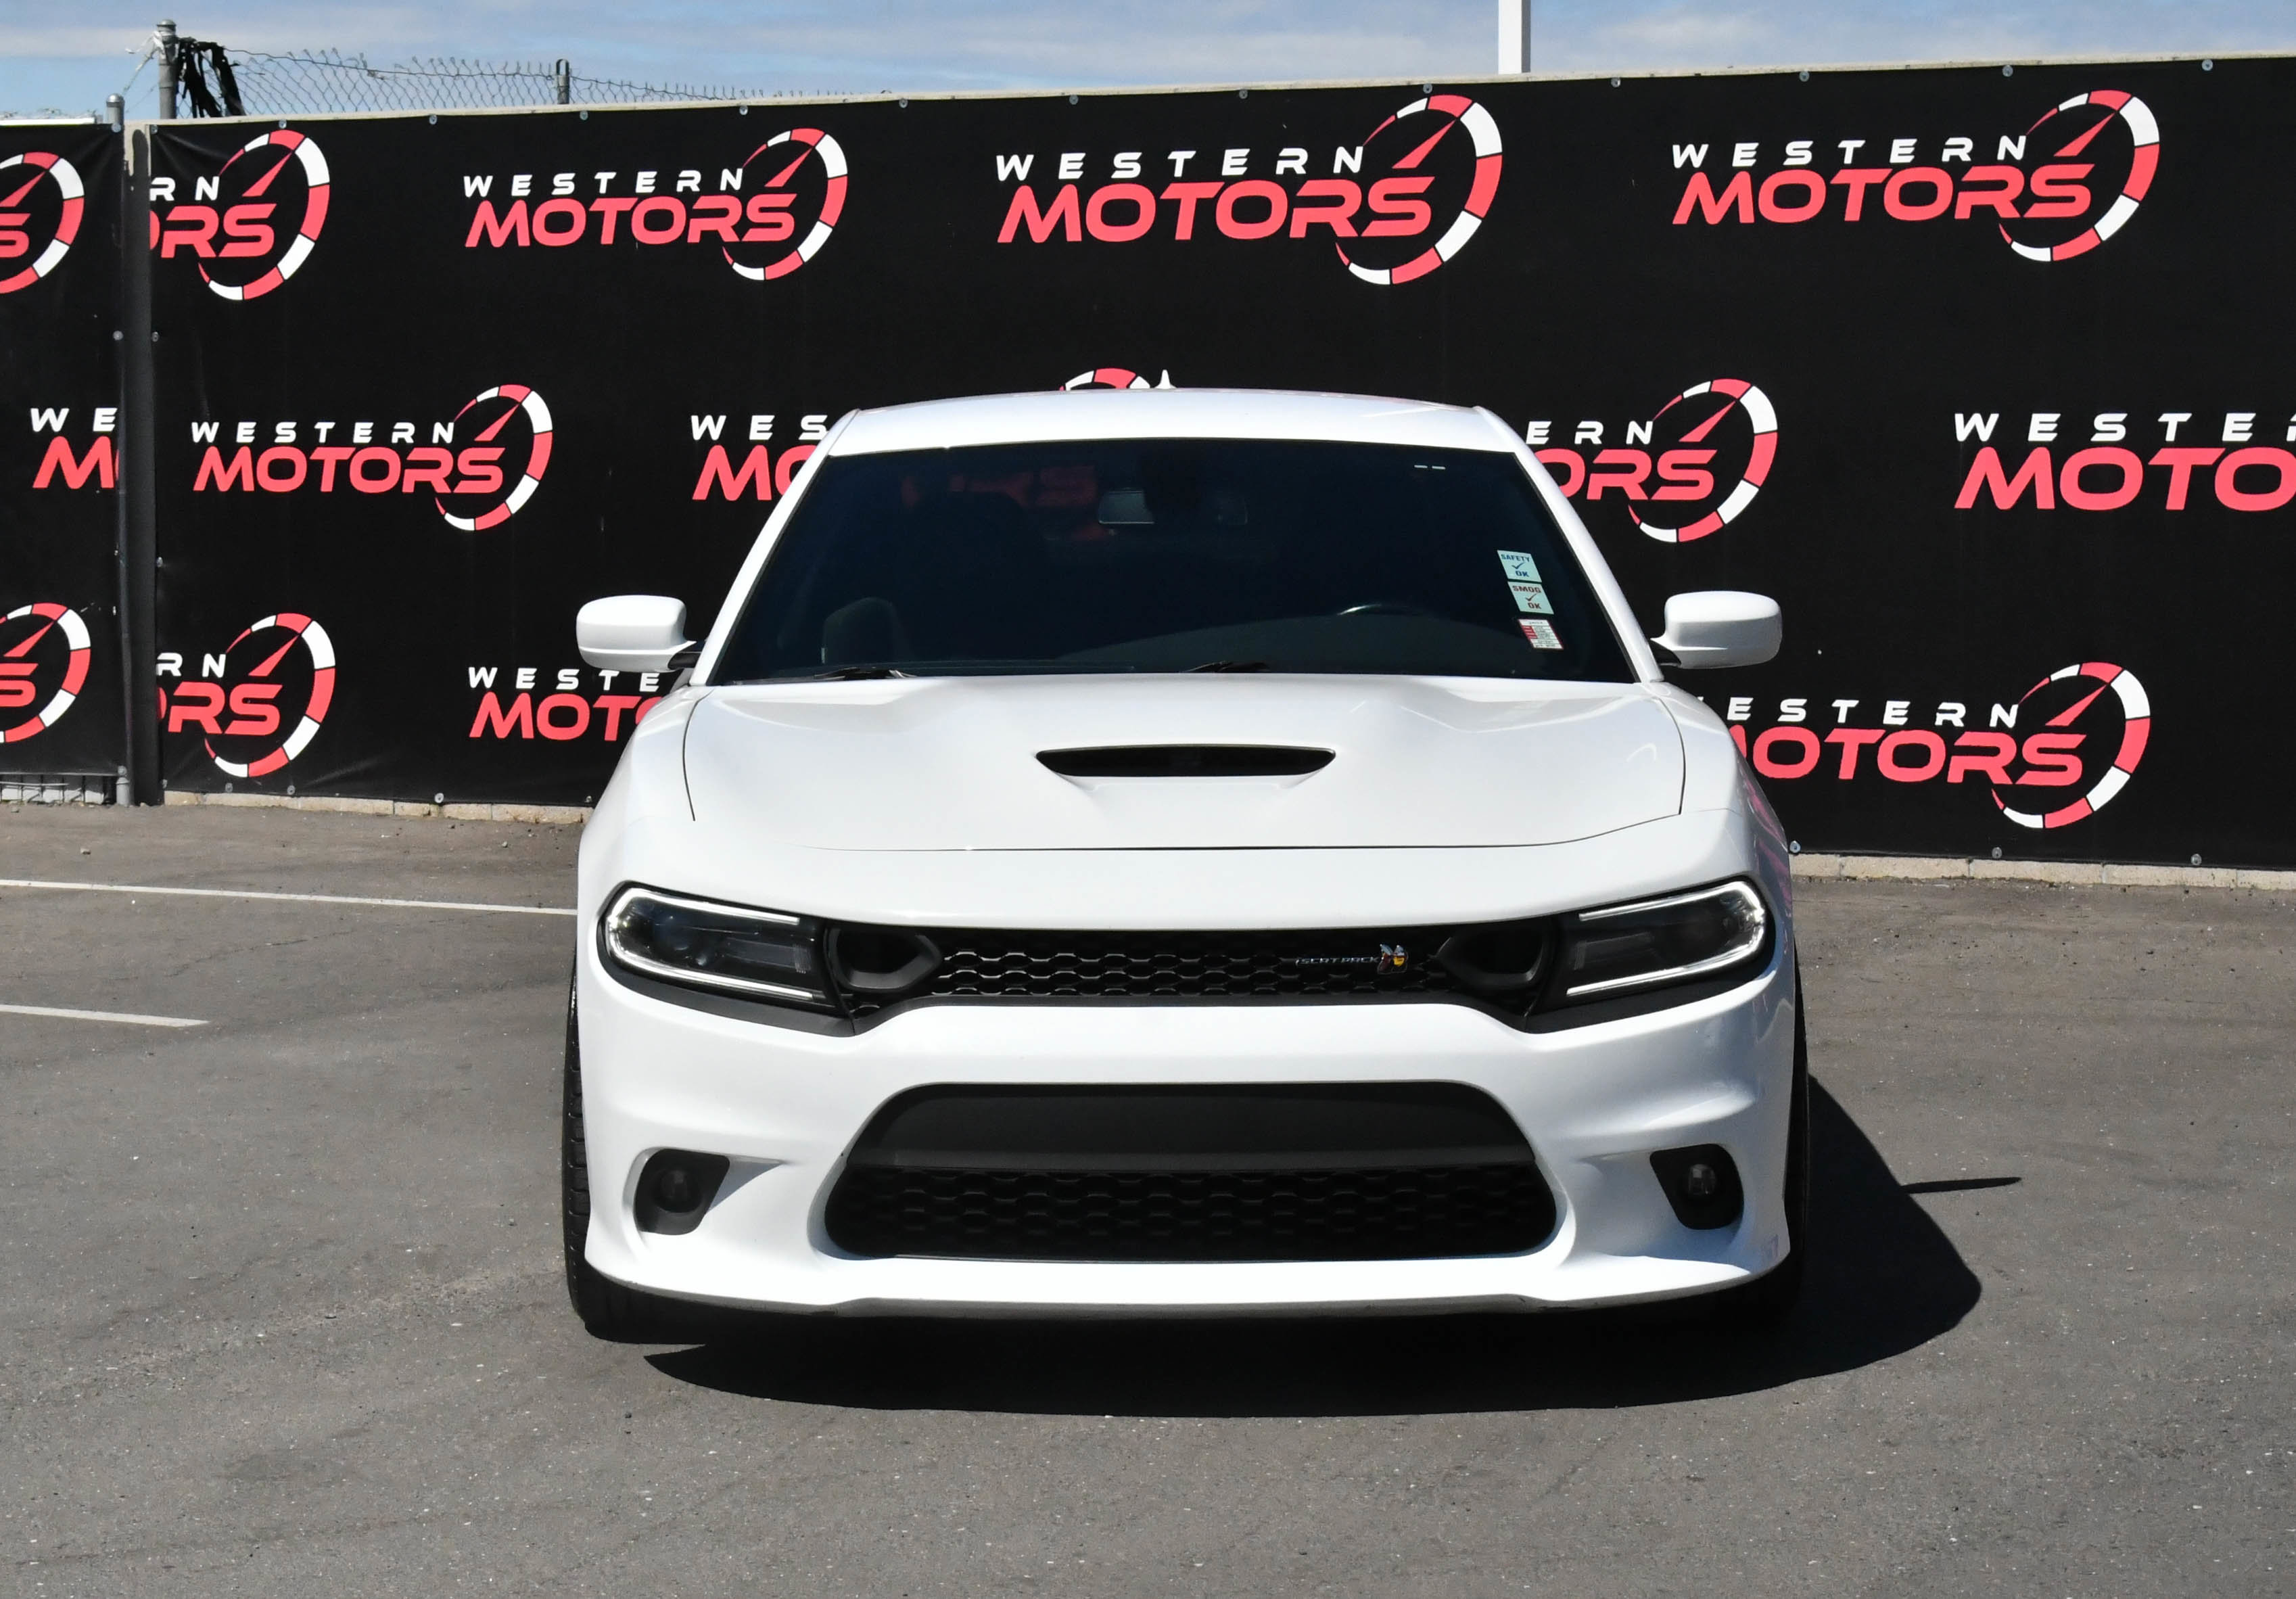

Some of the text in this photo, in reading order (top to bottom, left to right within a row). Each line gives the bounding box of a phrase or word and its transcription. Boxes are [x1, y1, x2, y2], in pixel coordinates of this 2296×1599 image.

[996, 145, 1363, 181] WESTERN
[1672, 135, 2027, 168] WESTERN
[463, 168, 743, 198] WESTERN
[1672, 164, 2094, 225] MOTORS
[149, 203, 277, 258] RS
[465, 193, 797, 248] MOTORS
[997, 176, 1435, 244] MOTORS
[191, 421, 454, 444] WESTERN
[193, 445, 506, 494] MOTORS
[1500, 553, 1530, 563] SAFETY
[1512, 585, 1542, 594] SMOG
[157, 681, 283, 735] RS
[469, 691, 663, 741] MOT
[1697, 696, 2019, 728] ESTERN
[1729, 724, 2087, 787] OTORS
